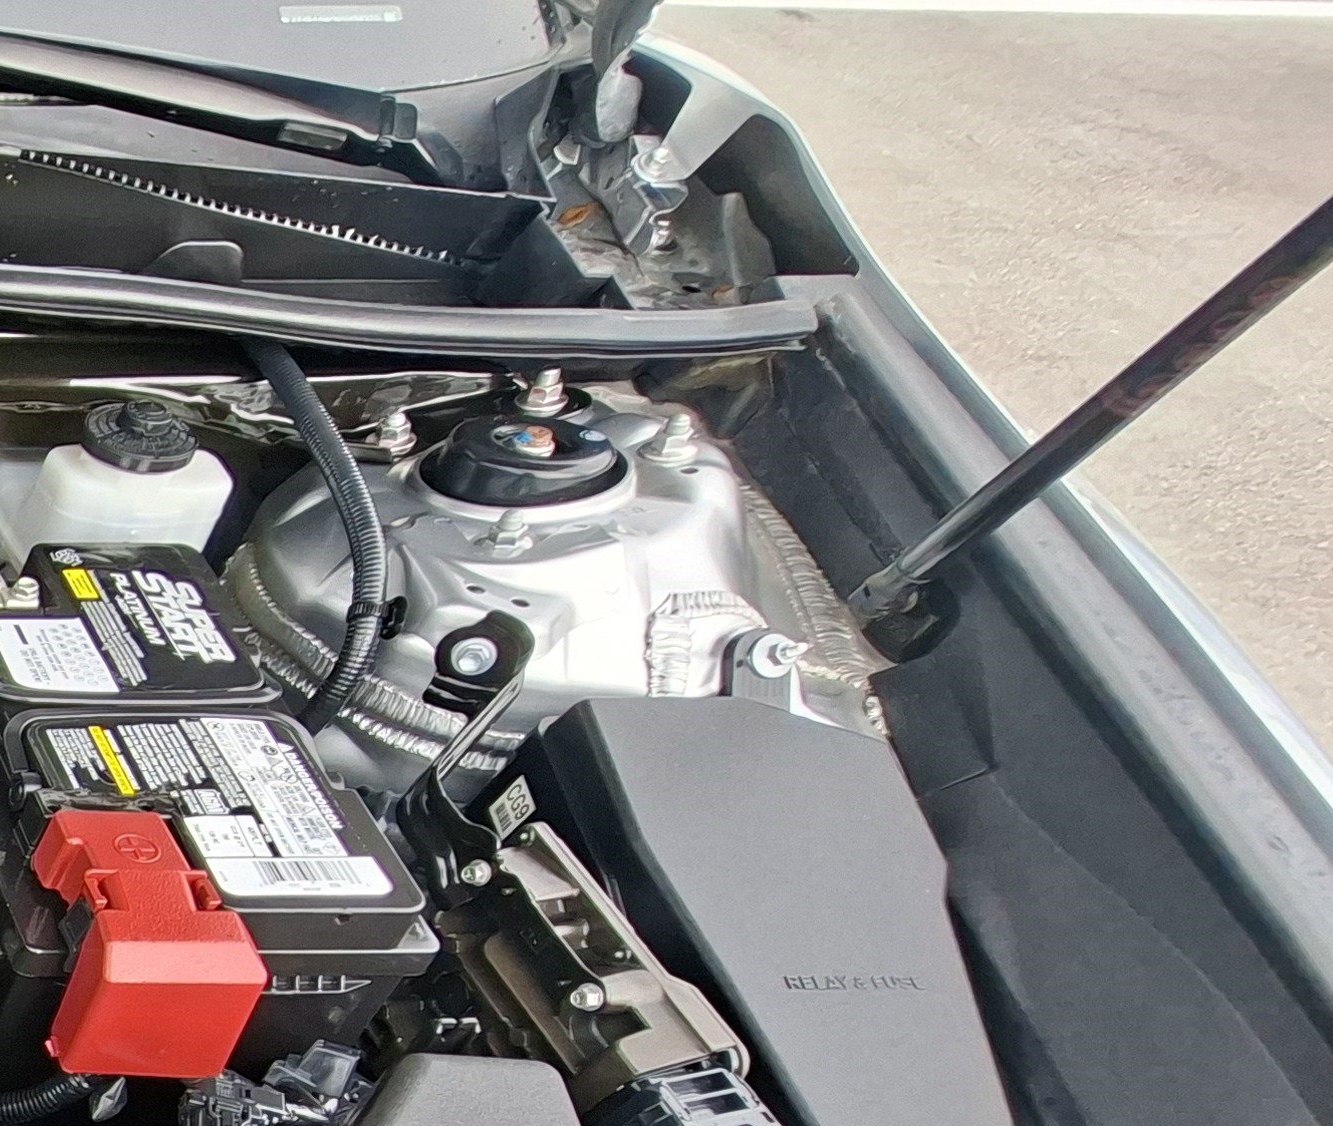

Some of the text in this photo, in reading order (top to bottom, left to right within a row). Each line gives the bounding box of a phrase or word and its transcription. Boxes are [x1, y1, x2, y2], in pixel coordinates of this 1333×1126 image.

[110, 573, 166, 645] PLATINUM
[135, 570, 213, 664] START
[175, 581, 237, 662] SUPER
[507, 784, 530, 820] CG9
[783, 975, 847, 991] RELAY
[871, 975, 927, 991] FUSE
